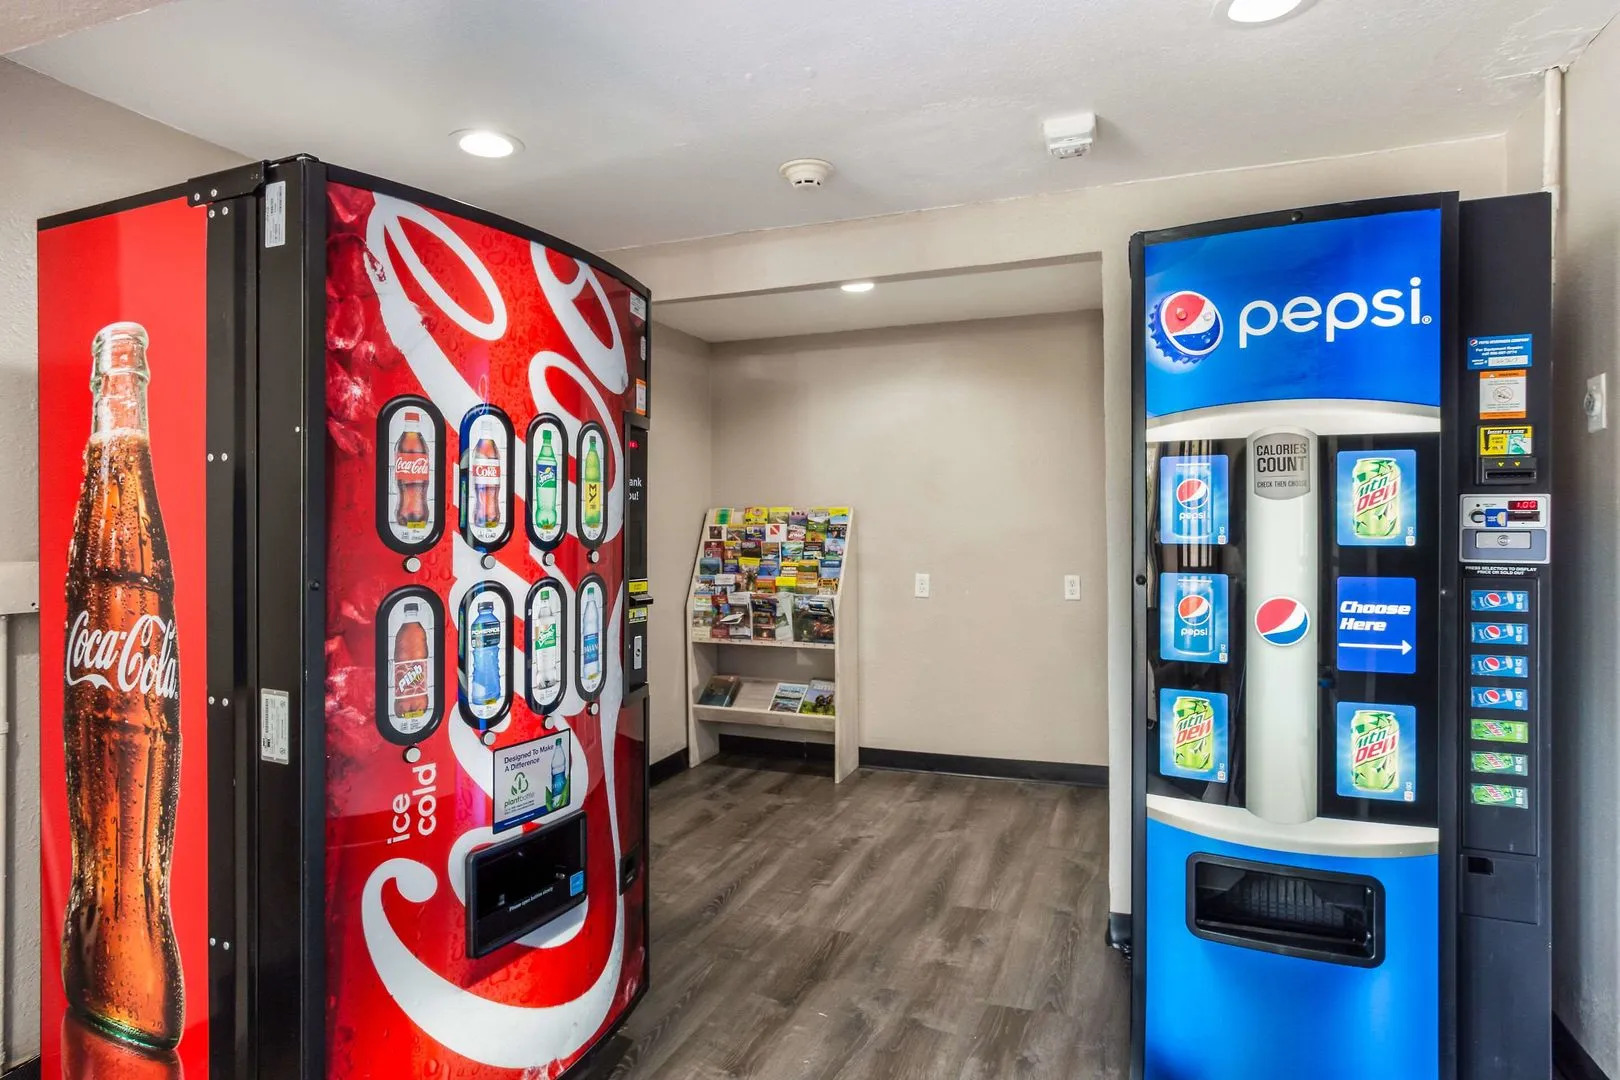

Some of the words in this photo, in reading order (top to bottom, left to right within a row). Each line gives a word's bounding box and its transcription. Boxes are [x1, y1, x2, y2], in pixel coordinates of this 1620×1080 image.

[1239, 277, 1421, 349] pepsi
[1256, 443, 1307, 456] CALORIES
[475, 465, 497, 477] Coke
[1257, 456, 1307, 473] COUNT
[629, 477, 642, 487] ank
[1256, 480, 1273, 488] CHECK
[1179, 510, 1206, 520] pepsi
[1340, 600, 1412, 616] Choose
[1180, 626, 1208, 637] pepsi
[1339, 617, 1387, 632] Here
[66, 610, 178, 699] Coca-Cola
[504, 750, 532, 764] Designed
[539, 744, 554, 753] Make
[504, 765, 510, 773] A
[510, 757, 540, 771] Difference
[412, 762, 437, 836] cold
[386, 792, 411, 845] ice
